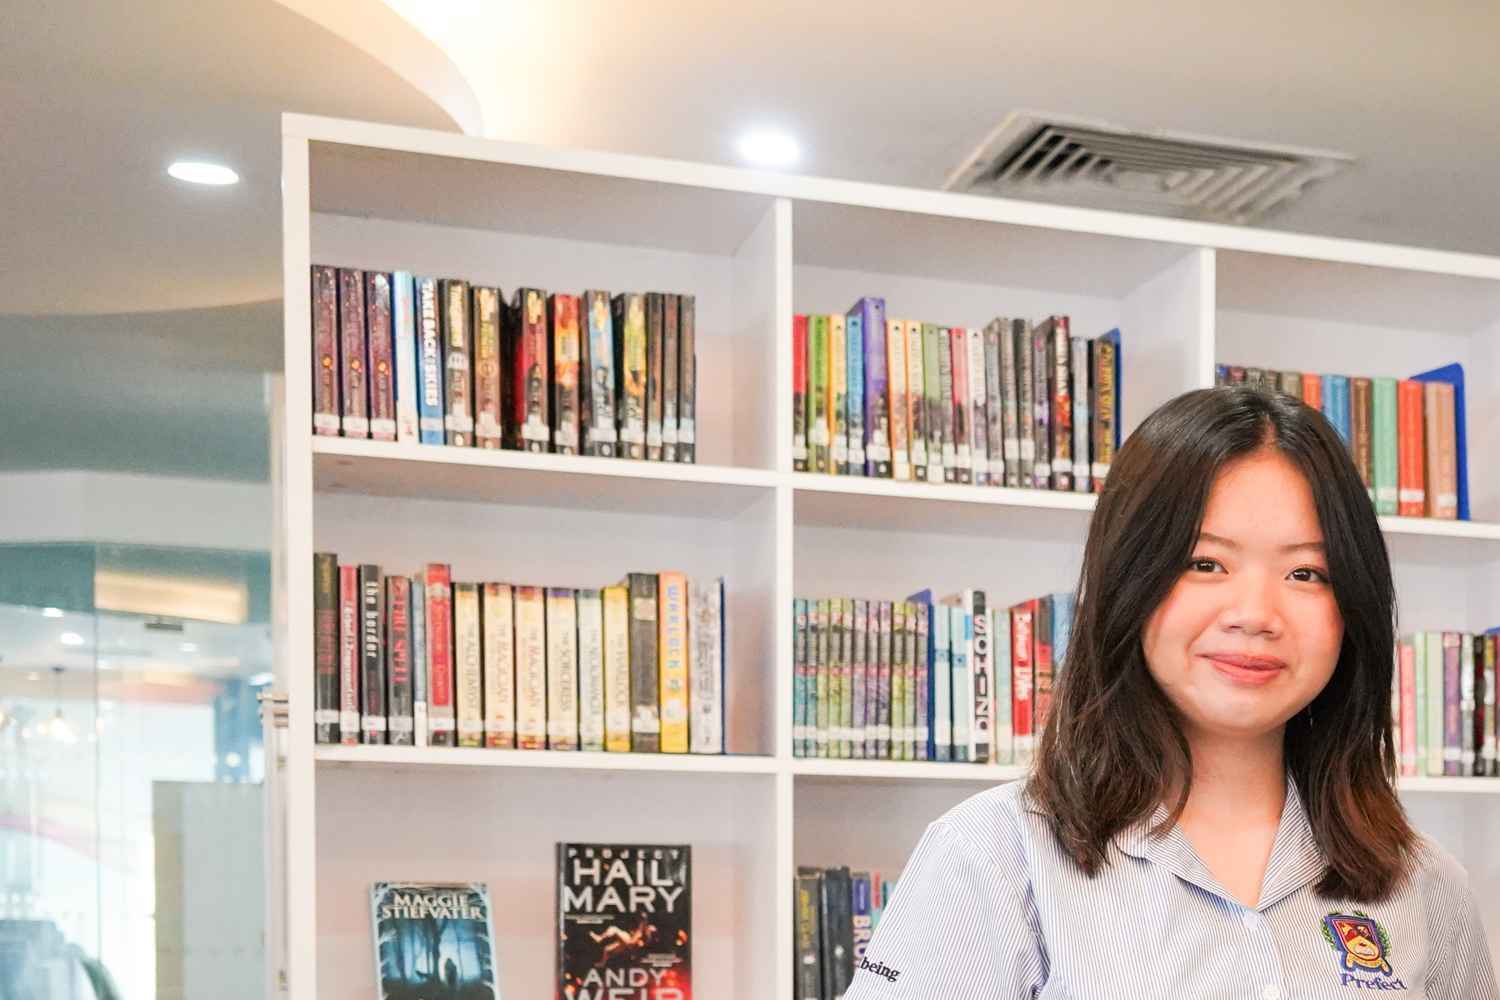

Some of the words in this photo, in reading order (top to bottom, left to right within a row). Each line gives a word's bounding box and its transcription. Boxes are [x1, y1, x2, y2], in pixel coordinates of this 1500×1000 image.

[423, 319, 437, 357] BACK
[366, 581, 378, 605] the
[366, 611, 378, 658] border
[568, 848, 679, 859] PROJECT
[573, 858, 674, 886] HAIL
[393, 893, 467, 908] MAGGIE
[563, 885, 683, 912] MARY
[382, 904, 482, 919] STIEFVATER
[582, 967, 667, 988] ANDY
[860, 956, 900, 982] being
[1340, 973, 1407, 991] Prefect
